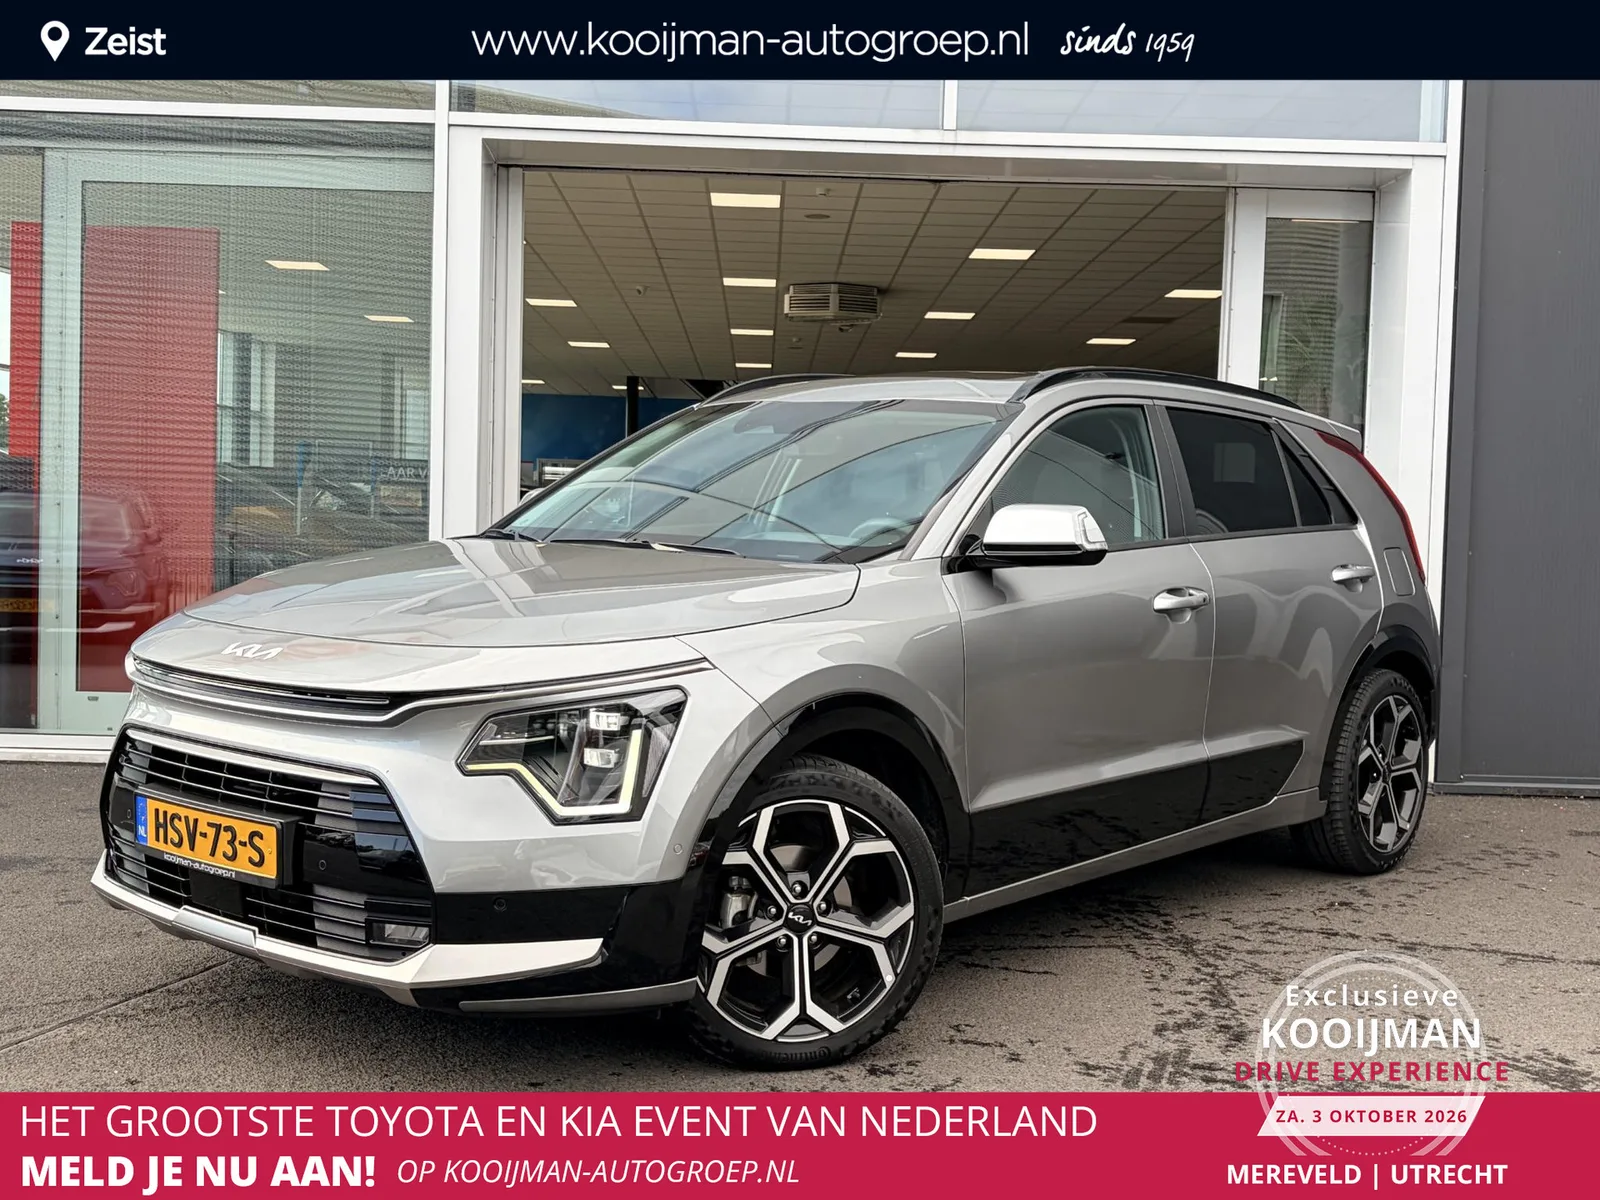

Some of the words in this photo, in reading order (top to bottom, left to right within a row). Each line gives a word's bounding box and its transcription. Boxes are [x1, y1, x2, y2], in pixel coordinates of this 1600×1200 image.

[138, 825, 147, 838] NL
[154, 808, 266, 868] HSV-73-S
[163, 852, 236, 879] kooijman-autogroep.nl
